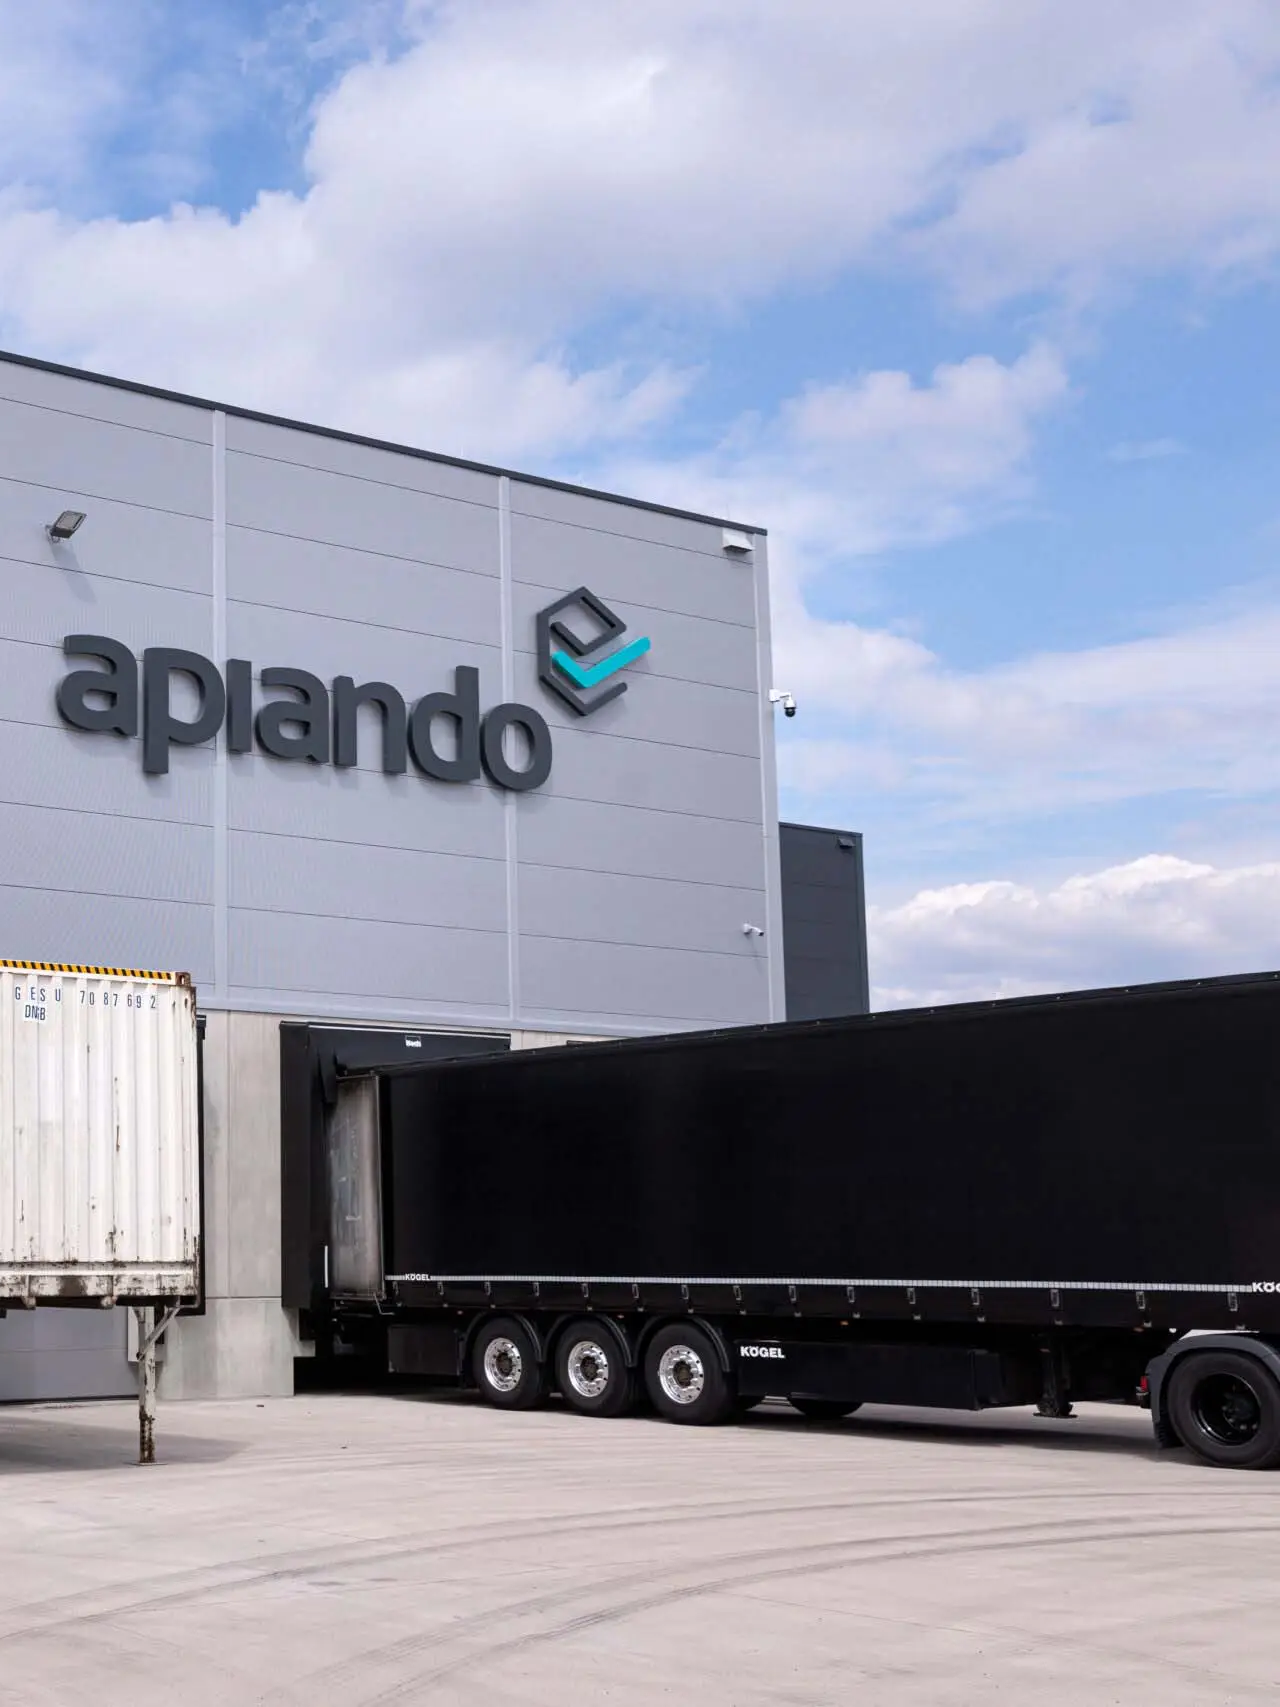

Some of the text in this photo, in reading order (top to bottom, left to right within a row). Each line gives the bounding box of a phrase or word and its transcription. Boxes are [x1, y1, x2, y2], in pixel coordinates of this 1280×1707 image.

[56, 634, 553, 791] apiando
[14, 986, 61, 1002] GESU
[740, 1345, 786, 1359] KÖGEL
